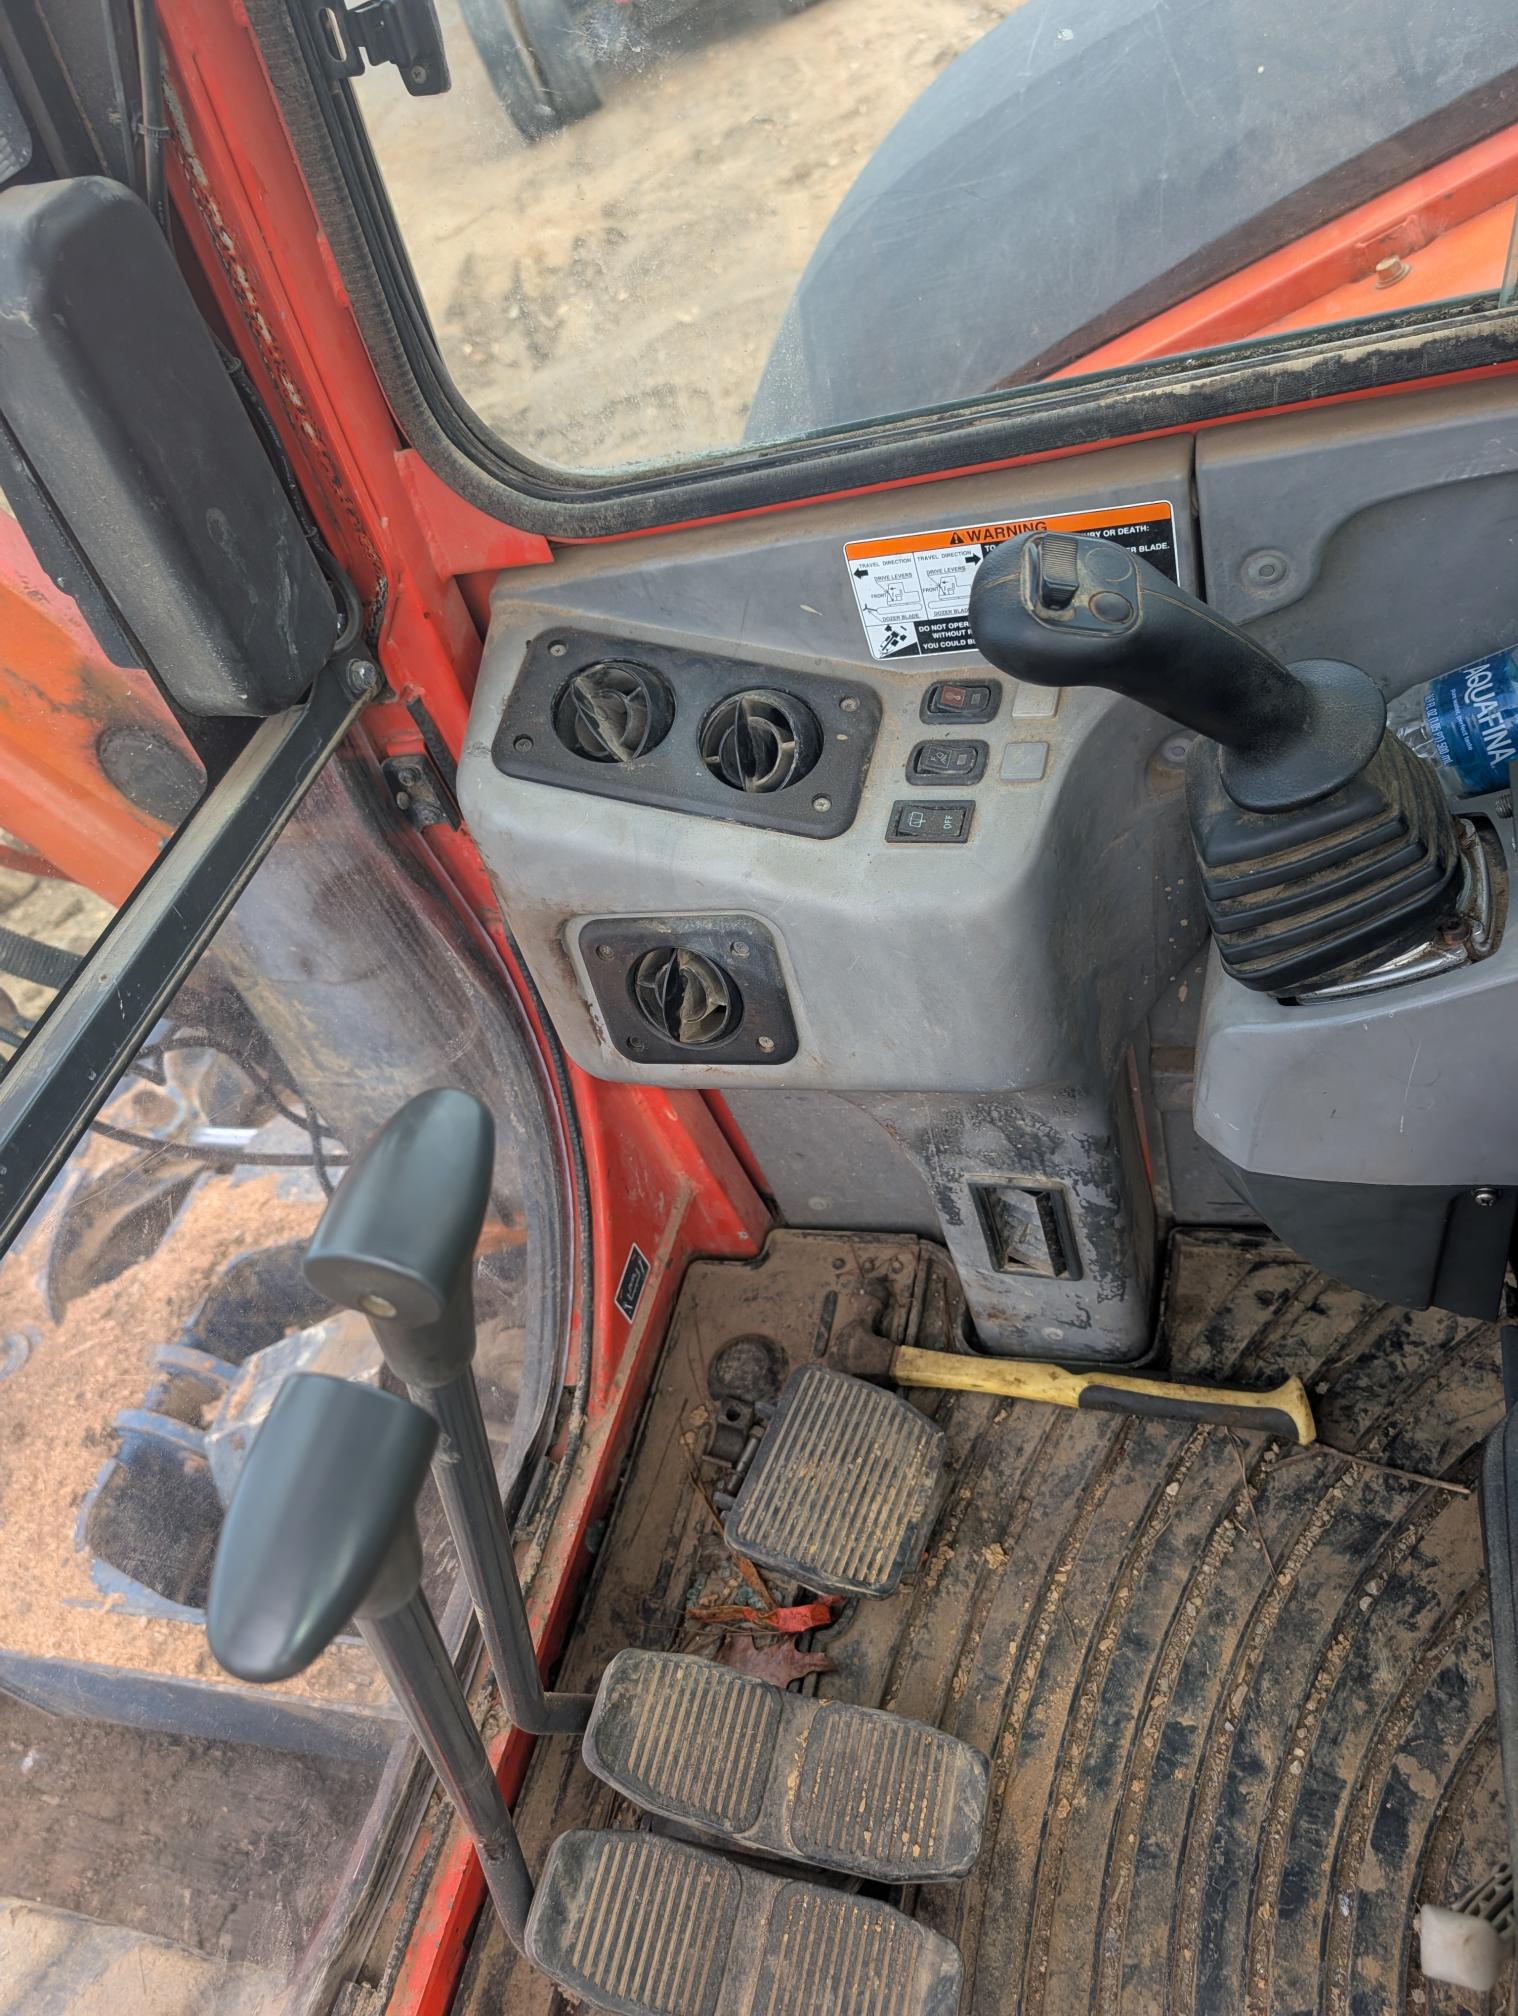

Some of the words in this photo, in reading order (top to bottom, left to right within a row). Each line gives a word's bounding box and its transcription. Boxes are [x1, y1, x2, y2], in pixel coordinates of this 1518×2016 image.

[967, 522, 1048, 542] WARNING
[1103, 529, 1115, 537] OR
[1117, 525, 1149, 535] DEATH:
[1139, 542, 1170, 553] BLADE.
[941, 550, 971, 559] DIRECTION
[859, 561, 880, 569] TRAVEL
[882, 558, 912, 566] DIRECTION
[953, 607, 969, 615] BLAD
[932, 630, 966, 639] WITHOUT
[940, 640, 966, 648] COULD
[1463, 664, 1517, 766] AQUAFINA
[1437, 741, 1450, 755] 500
[943, 815, 953, 830] OFF
